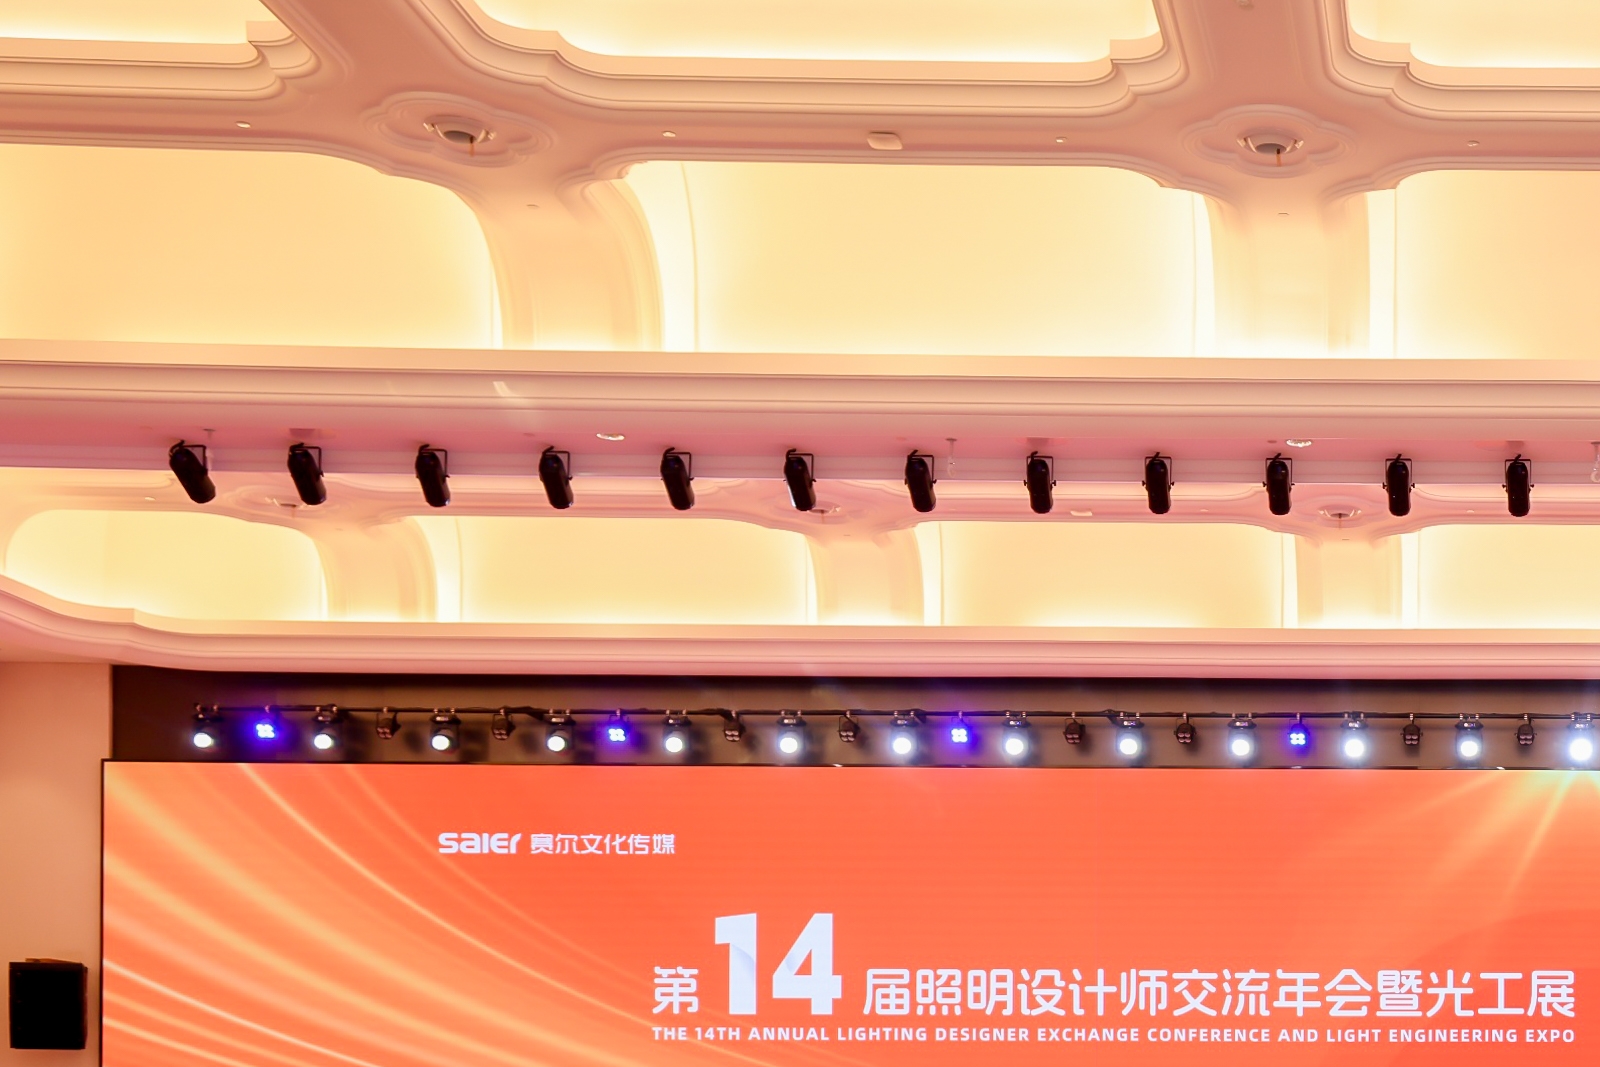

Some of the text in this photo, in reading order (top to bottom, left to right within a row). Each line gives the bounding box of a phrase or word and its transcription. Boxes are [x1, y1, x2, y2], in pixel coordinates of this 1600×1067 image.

[530, 833, 676, 855] 赛尔文化传媒
[652, 1027, 1576, 1042] THE 14TH ANNUAL LIGHTING DESIGNER EXCHANGE CONFERENCE AND LIGHT ENGINEERING EXPO
